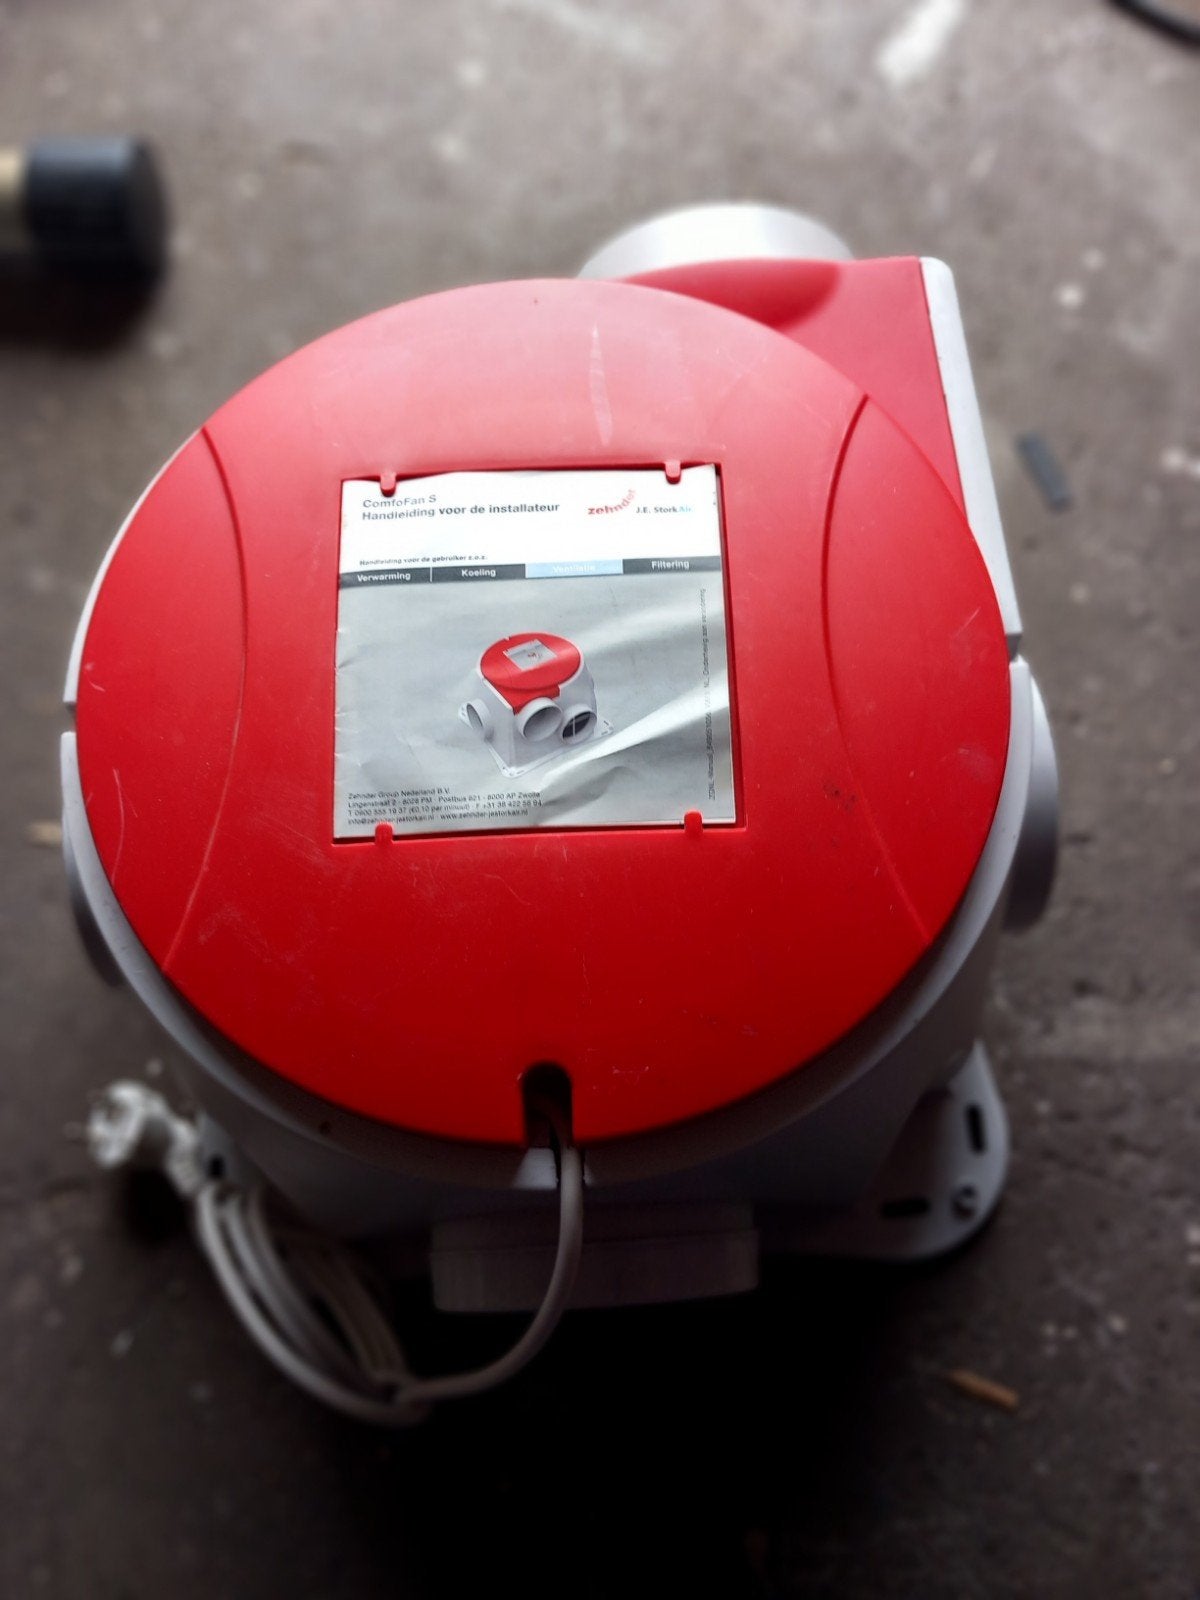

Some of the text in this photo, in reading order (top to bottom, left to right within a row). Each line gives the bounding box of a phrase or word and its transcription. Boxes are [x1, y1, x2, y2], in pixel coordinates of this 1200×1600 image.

[362, 494, 437, 508] ComfoFan S
[587, 489, 636, 515] zehnder
[362, 503, 560, 521] Handleiding voor de installateur
[359, 557, 402, 566] Handleiding
[432, 554, 466, 563] gebruiker
[651, 560, 690, 570] Filtering
[357, 572, 411, 583] Verwarming
[461, 568, 497, 578] Koeling
